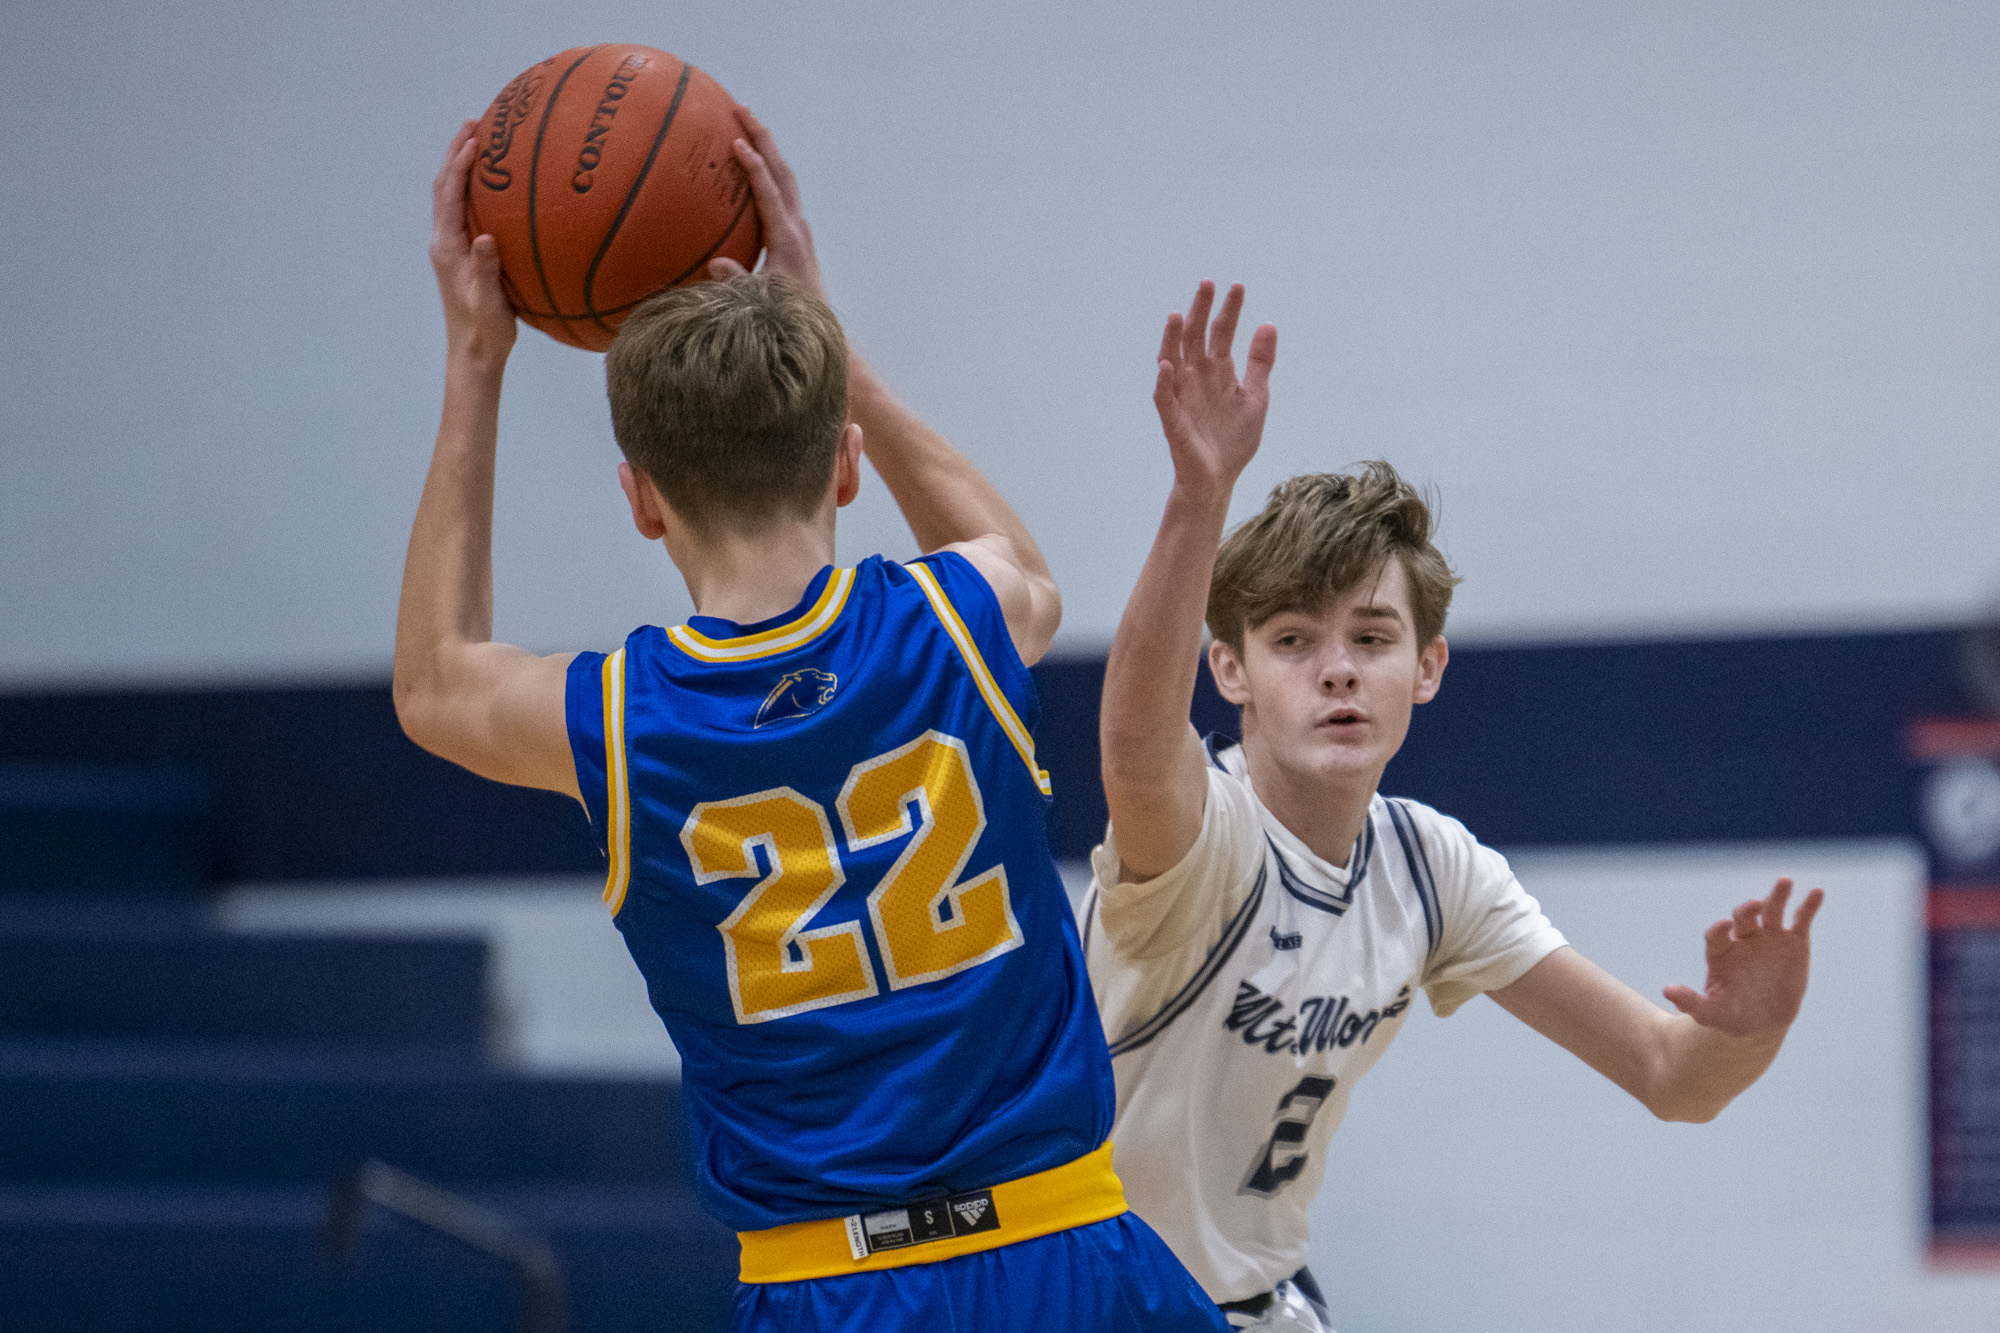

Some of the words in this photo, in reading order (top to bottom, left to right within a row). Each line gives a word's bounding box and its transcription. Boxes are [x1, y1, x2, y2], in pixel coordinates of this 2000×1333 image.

[480, 66, 541, 191] Rawl
[679, 728, 1025, 1025] 22
[1236, 1073, 1337, 1200] 2
[852, 1228, 864, 1257] LENGTH
[925, 1210, 934, 1225] S
[954, 1198, 989, 1212] adidas
